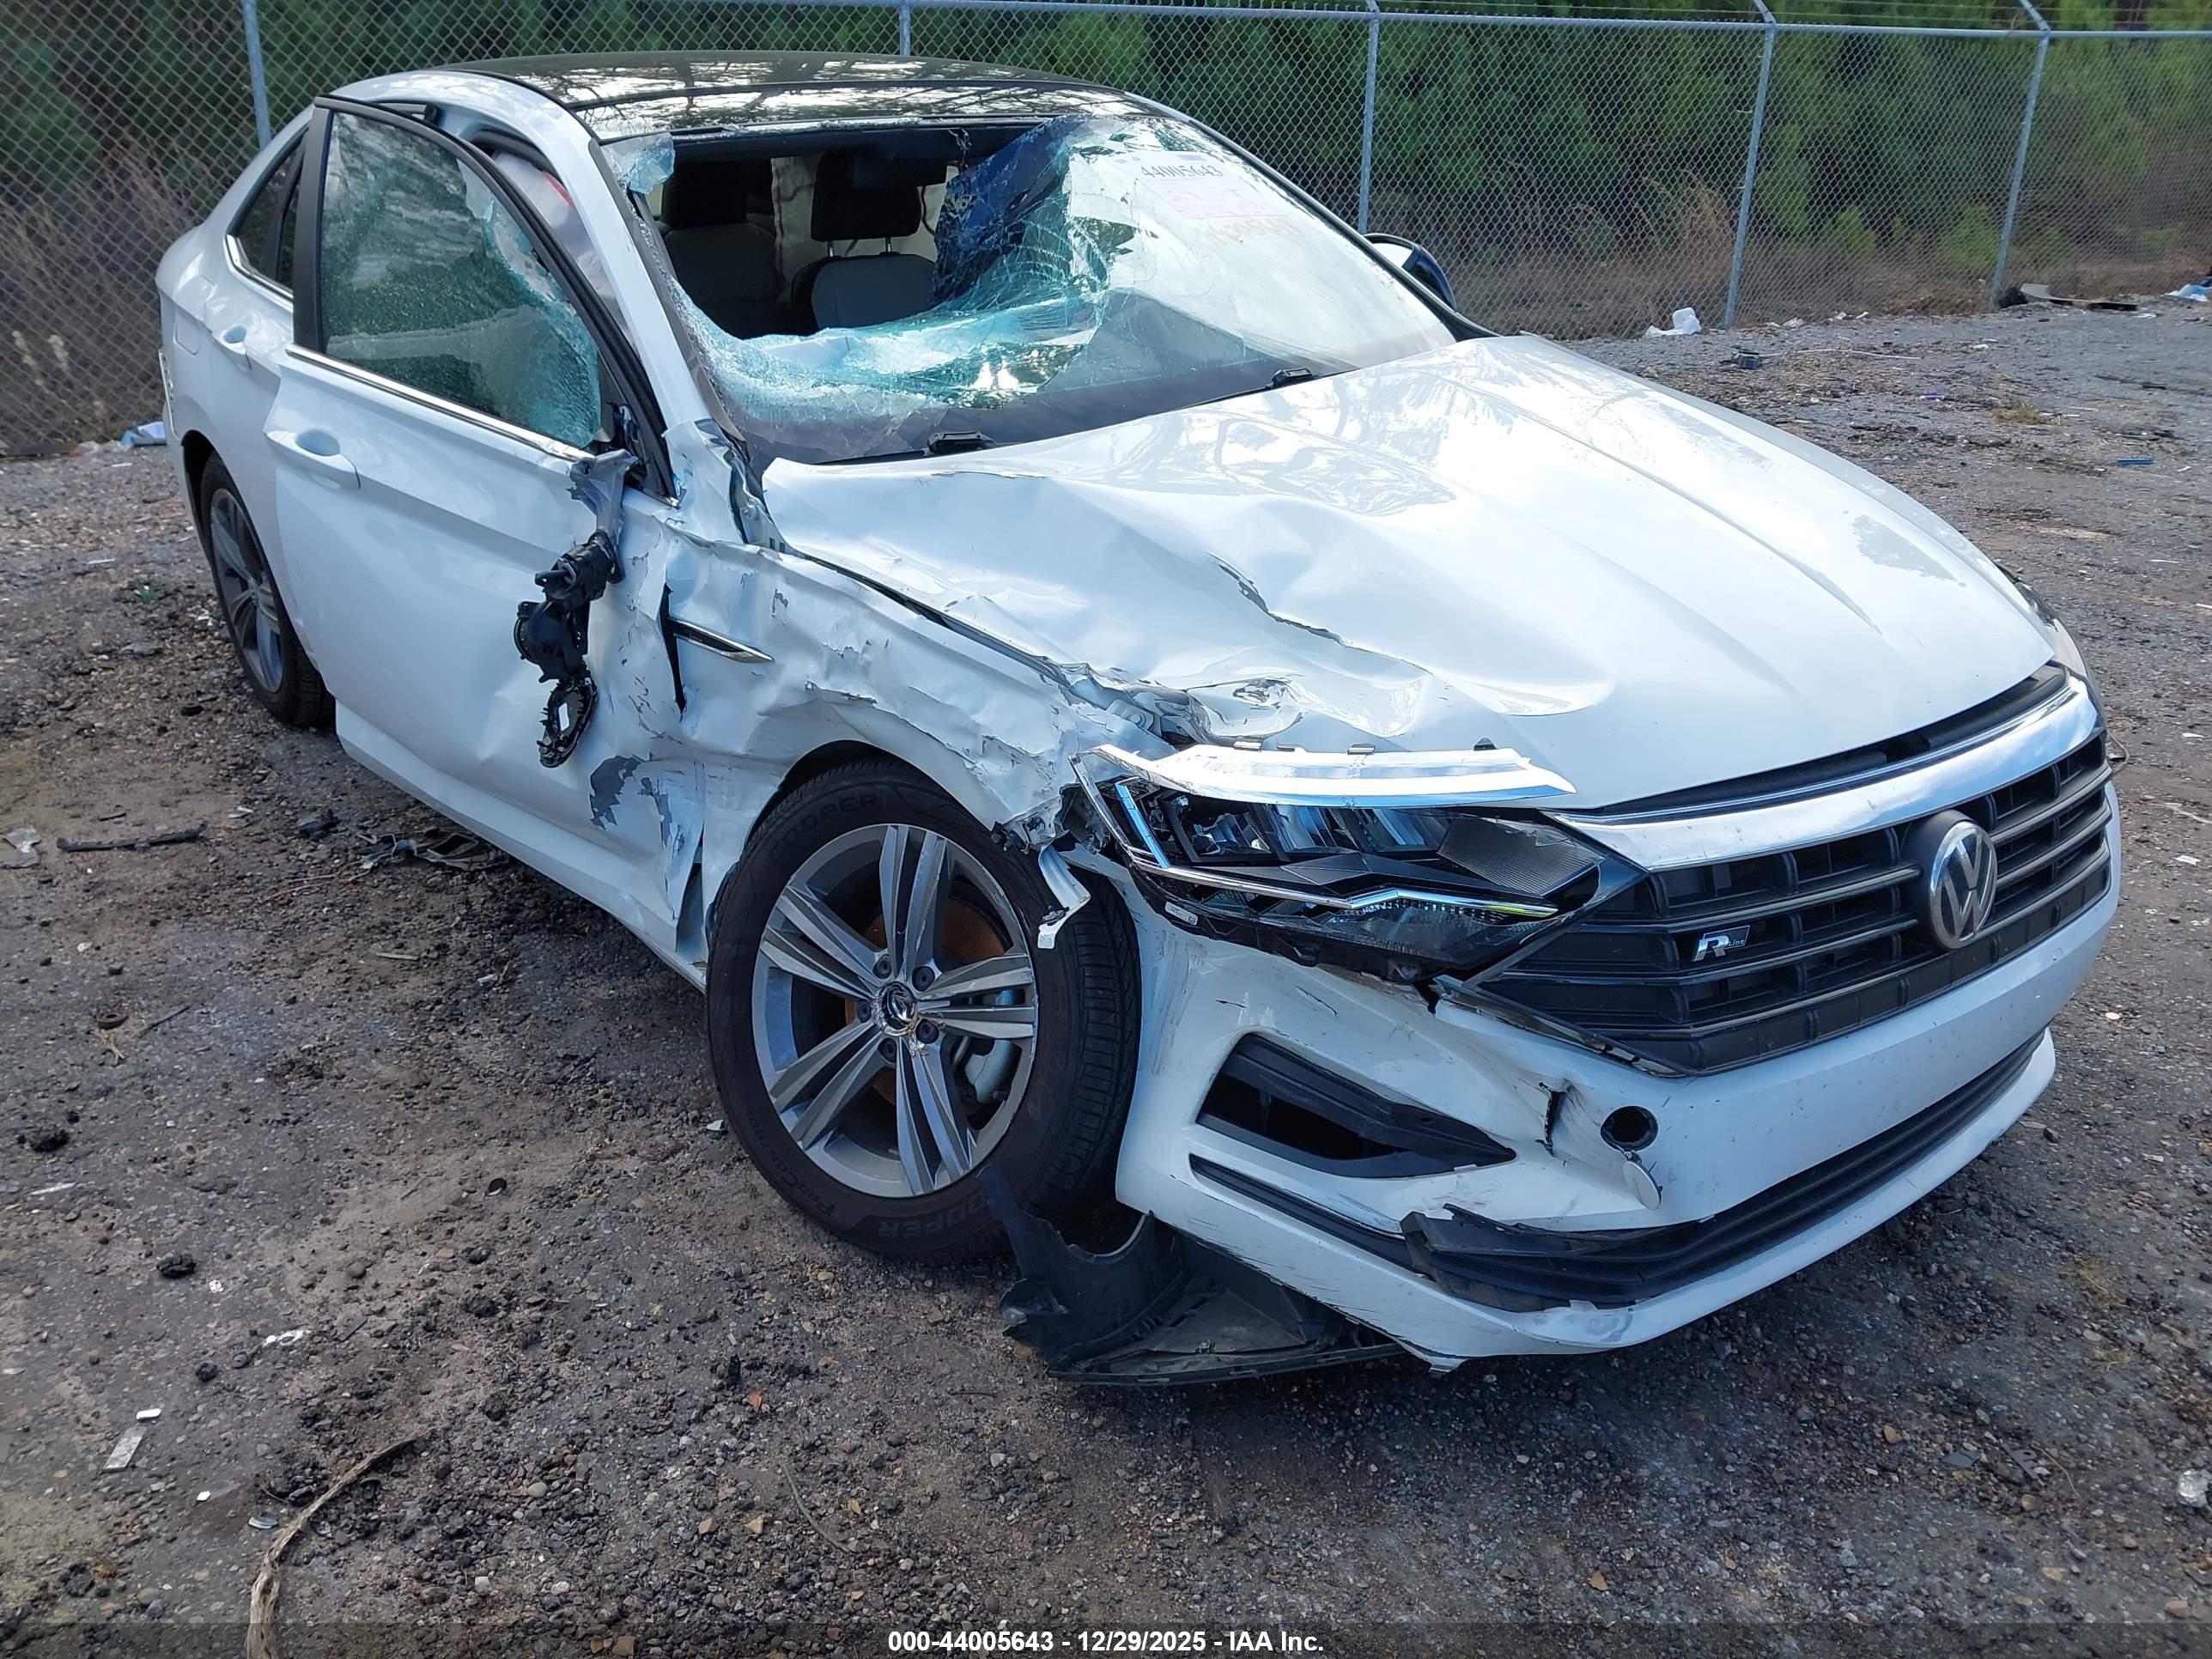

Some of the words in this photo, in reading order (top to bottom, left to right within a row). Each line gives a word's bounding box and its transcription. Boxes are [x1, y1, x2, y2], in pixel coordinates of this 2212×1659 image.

[1140, 165, 1224, 178] 44005643
[769, 793, 881, 862] COOPER
[878, 1194, 986, 1238] OOPER
